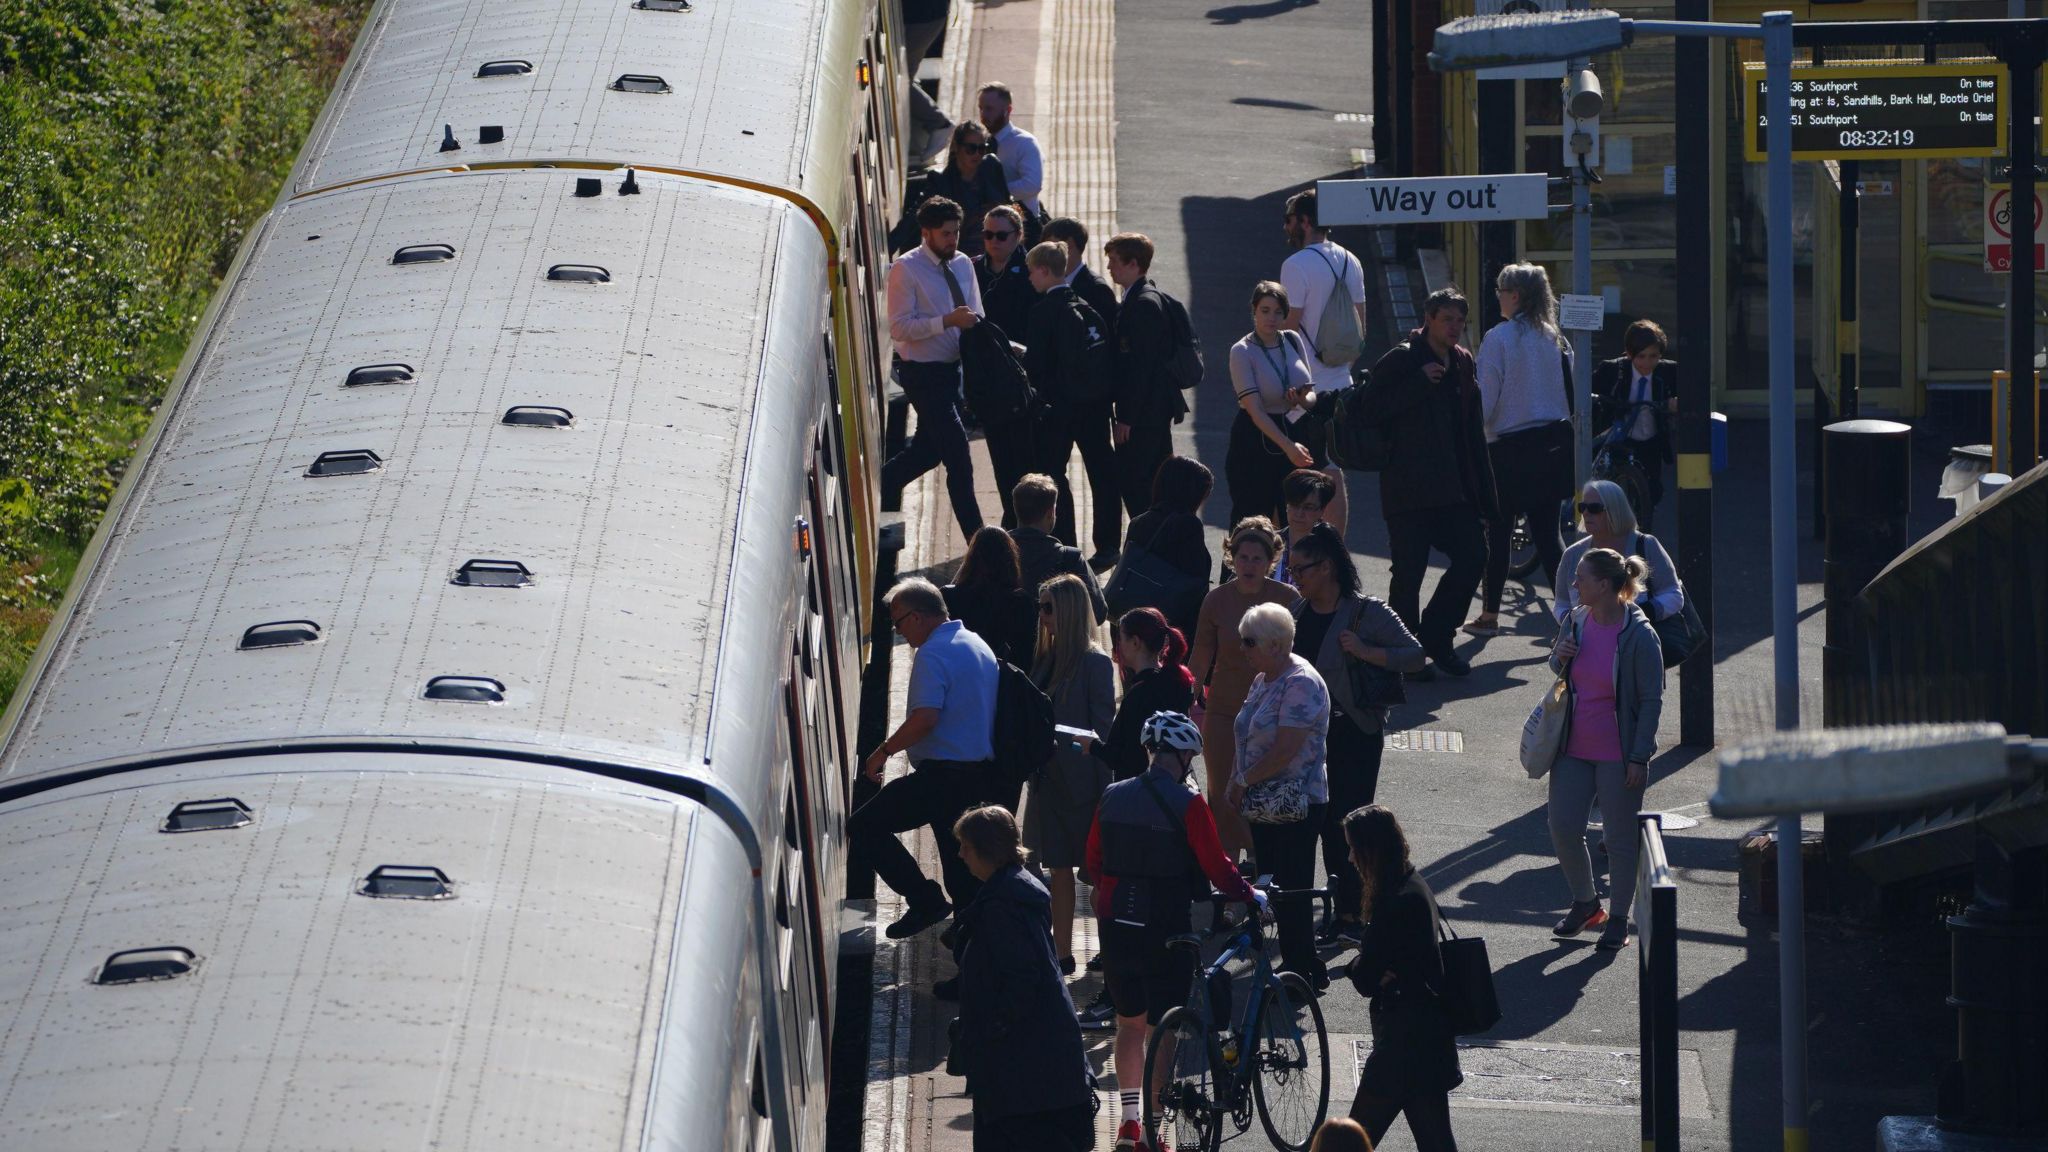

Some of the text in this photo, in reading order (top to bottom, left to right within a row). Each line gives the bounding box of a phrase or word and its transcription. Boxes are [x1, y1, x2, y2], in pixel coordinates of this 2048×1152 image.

[1810, 81, 1858, 94] Southport
[1960, 78, 1972, 88] On
[1976, 79, 1994, 88] time
[1843, 94, 1887, 107] Sandhills,
[1890, 94, 1913, 105] Bank
[1916, 93, 1937, 105] Hall,
[1940, 93, 1969, 104] Bootle
[1972, 92, 1994, 103] Oriel
[1809, 114, 1858, 127] Southport
[1960, 111, 1972, 122] On
[1975, 112, 1994, 121] time
[1840, 129, 1914, 146] 08:32:19
[1370, 183, 1497, 216] Way out
